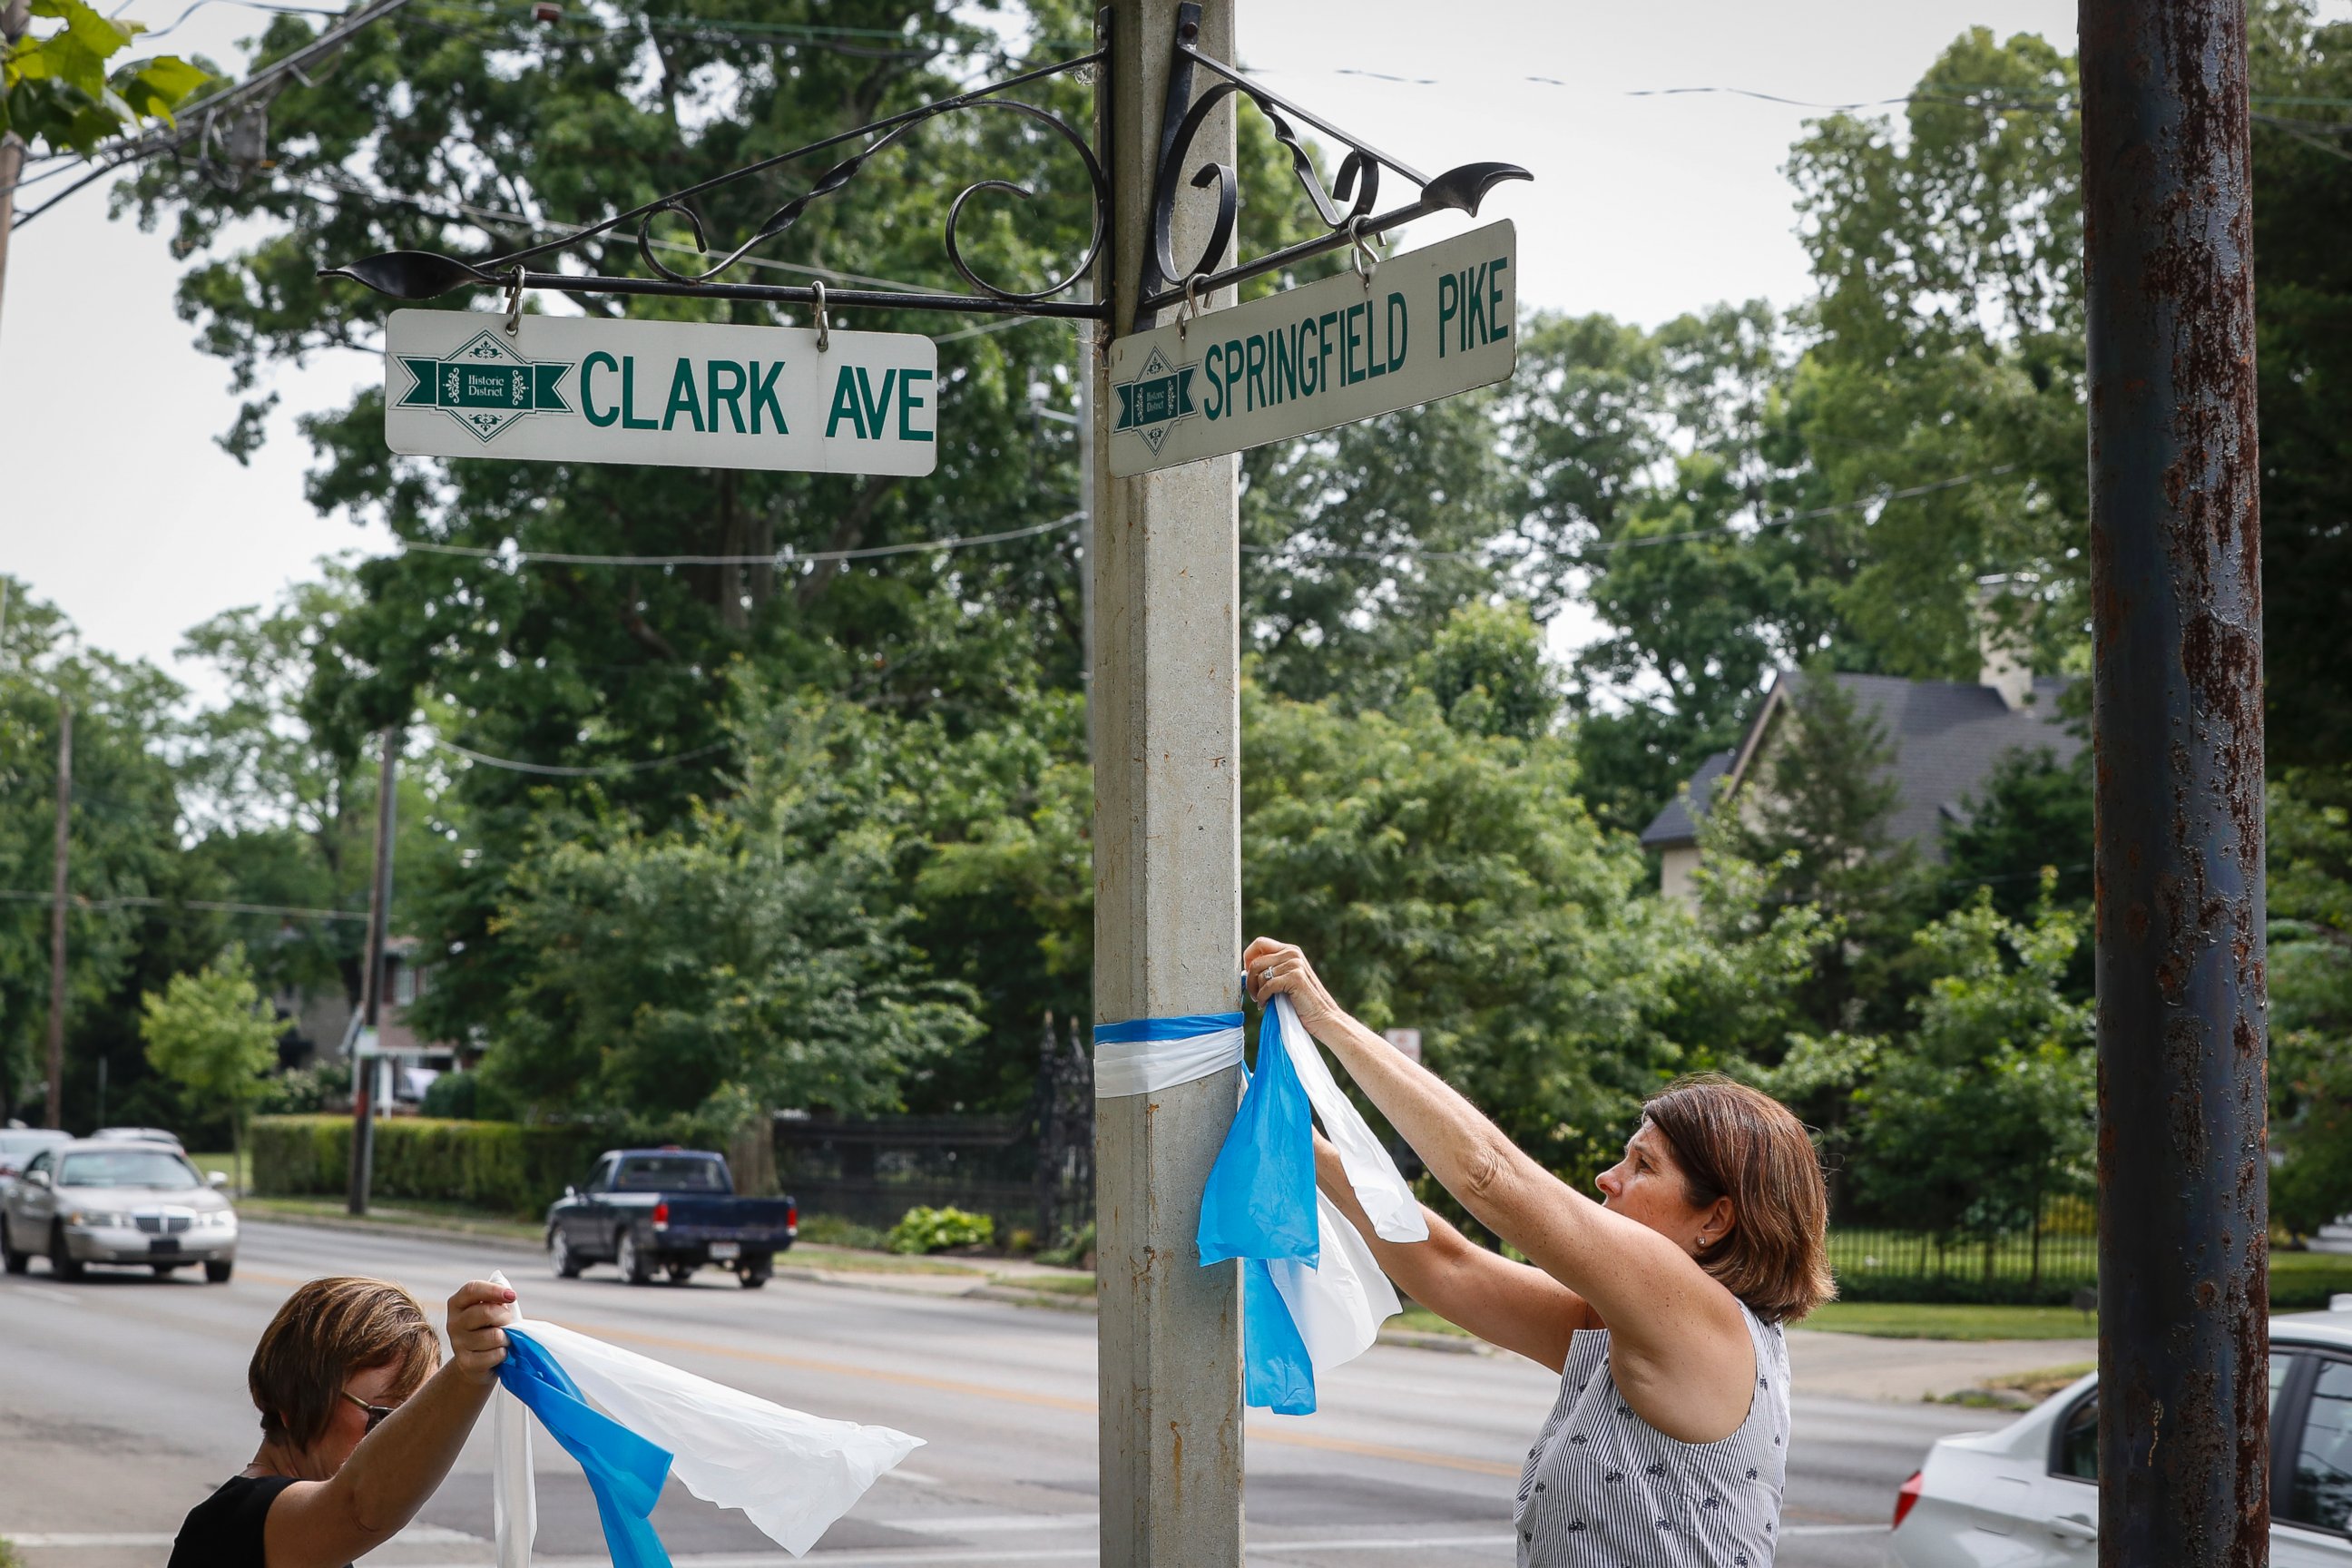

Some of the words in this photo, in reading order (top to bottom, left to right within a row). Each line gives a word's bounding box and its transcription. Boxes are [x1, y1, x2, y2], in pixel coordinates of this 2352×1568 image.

[1204, 292, 1407, 421] SPRINGFIELD
[1439, 257, 1508, 358] PIKE
[468, 375, 505, 387] Historic
[468, 385, 504, 397] District
[581, 351, 789, 435] CLARK
[826, 366, 934, 442] AVE
